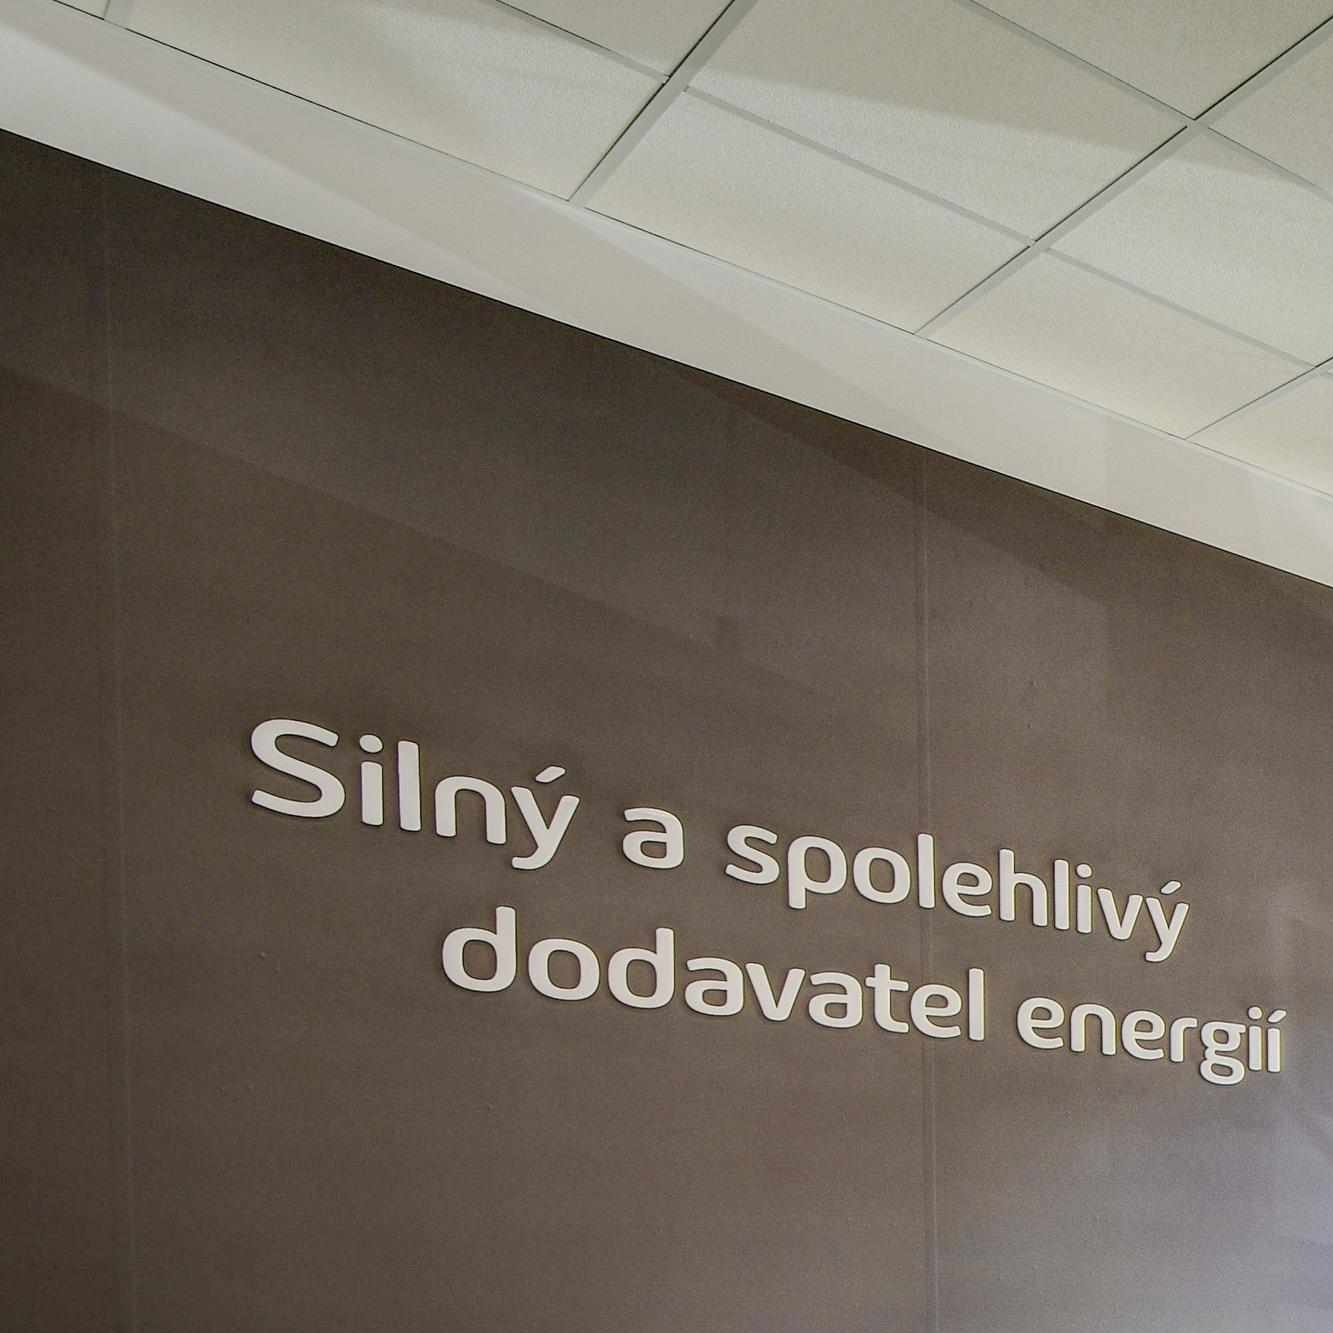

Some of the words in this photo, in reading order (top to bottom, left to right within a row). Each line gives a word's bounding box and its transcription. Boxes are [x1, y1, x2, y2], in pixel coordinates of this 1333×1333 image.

[250, 717, 580, 870] Silný
[622, 806, 685, 869] a
[724, 821, 1190, 964] spolehlivý
[441, 906, 985, 1042] dodavatel
[1015, 994, 1287, 1087] energií
